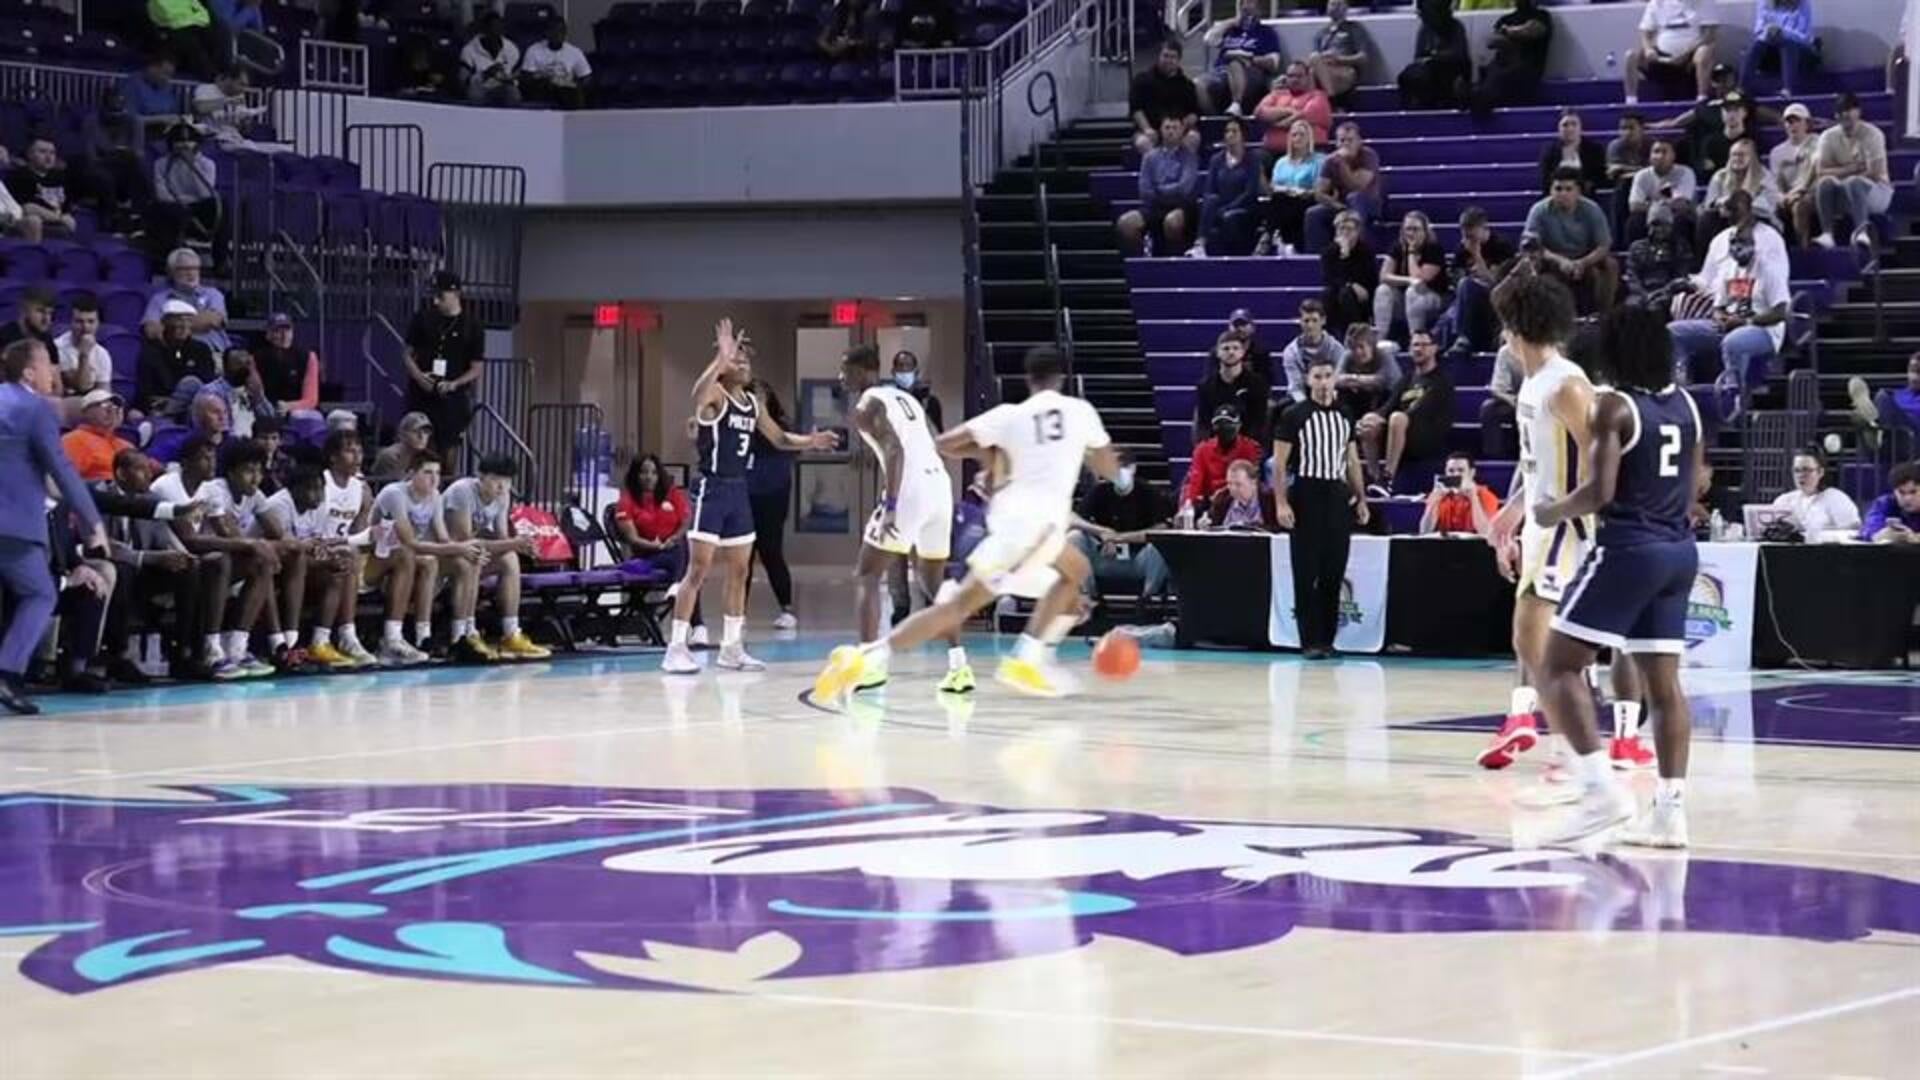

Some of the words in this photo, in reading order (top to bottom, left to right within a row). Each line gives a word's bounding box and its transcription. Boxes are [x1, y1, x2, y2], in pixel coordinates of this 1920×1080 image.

[896, 396, 916, 421] 0
[1034, 409, 1064, 445] 13
[737, 433, 750, 456] 3
[1659, 425, 1681, 477] 2
